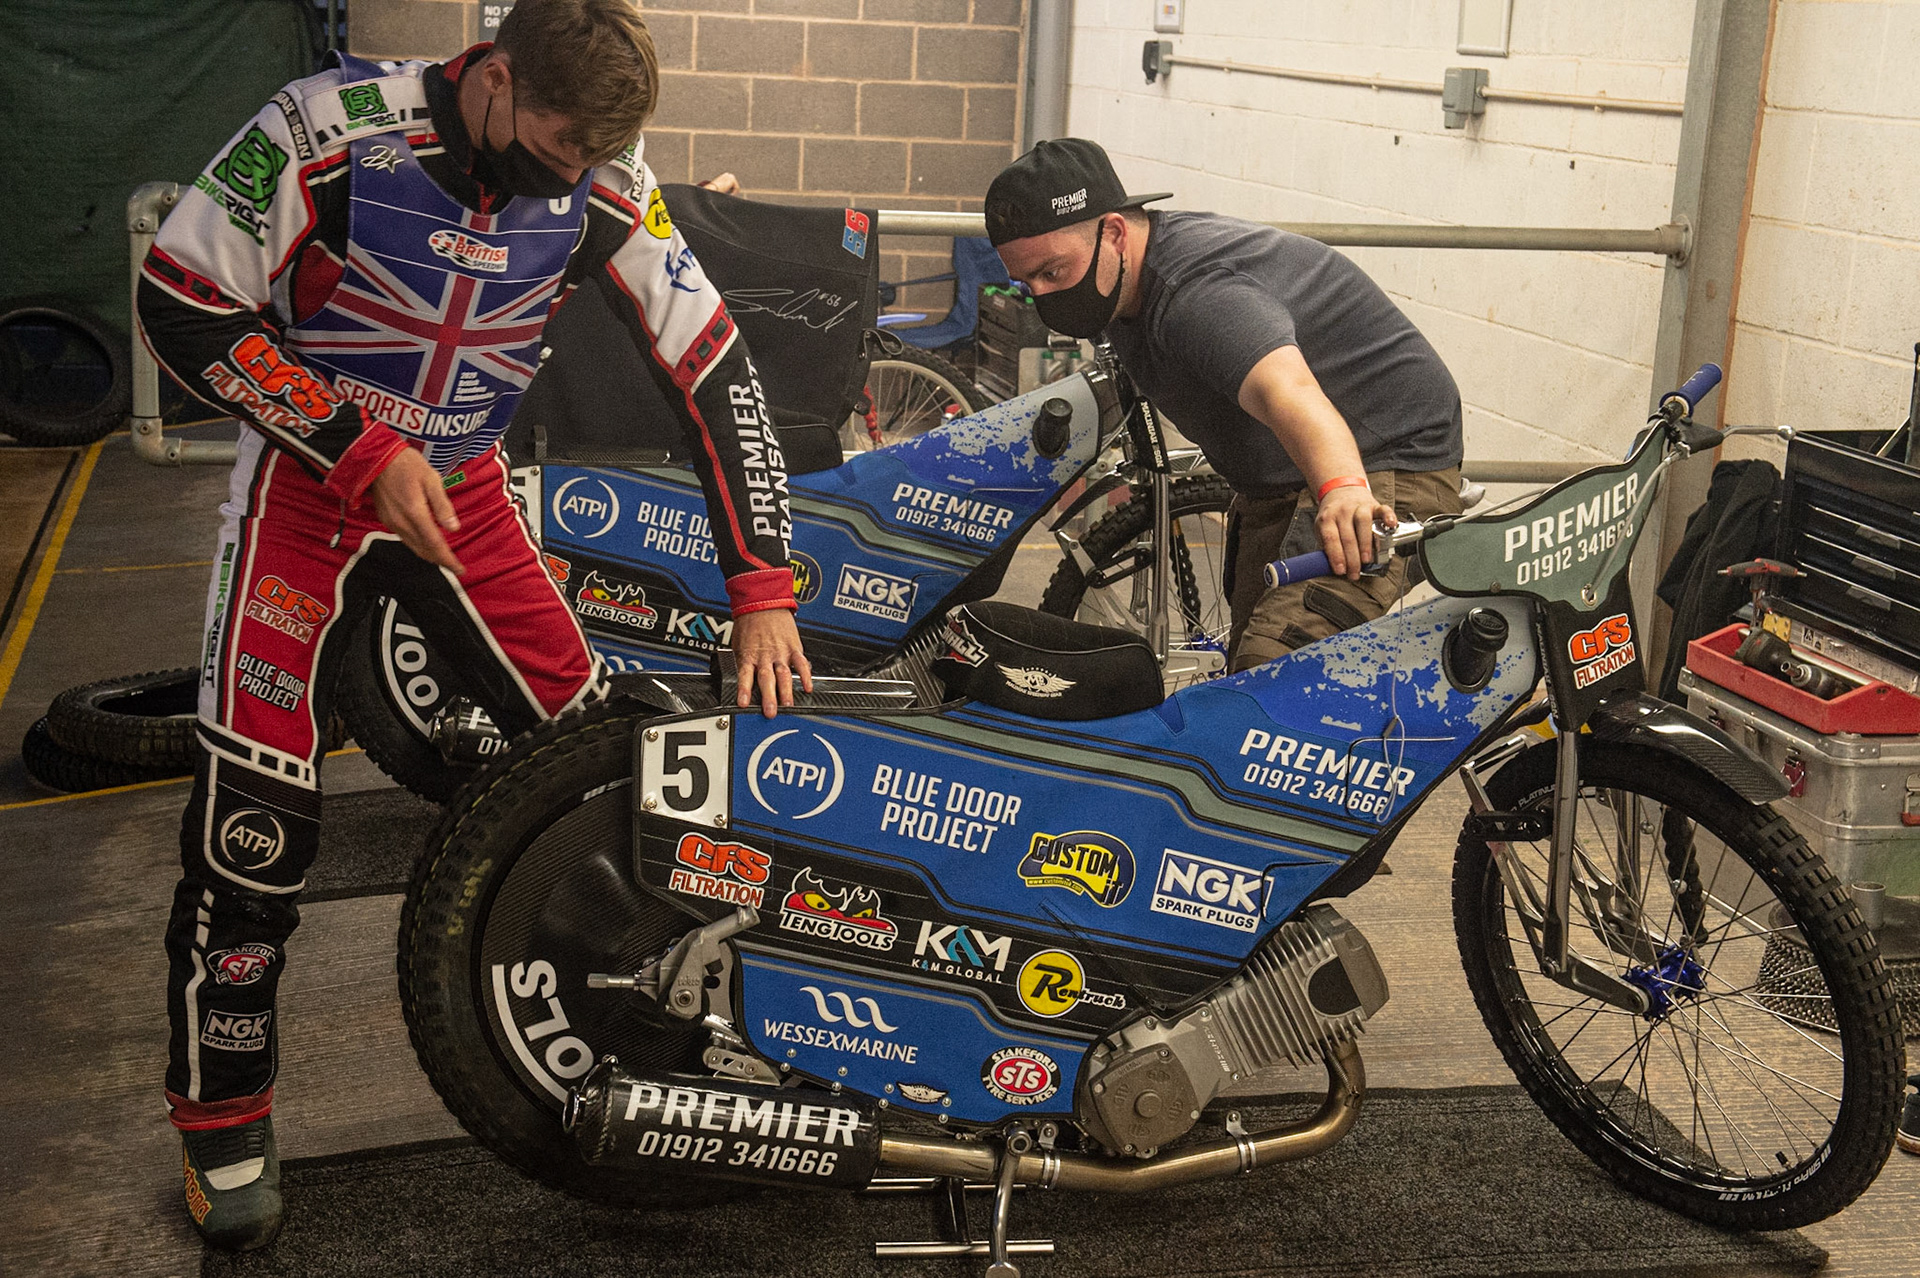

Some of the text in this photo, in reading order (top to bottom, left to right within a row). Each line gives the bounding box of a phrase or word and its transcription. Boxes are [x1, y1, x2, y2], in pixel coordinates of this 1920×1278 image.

[1051, 188, 1088, 209] PREMIER
[201, 361, 320, 438] FILTRATION
[229, 333, 343, 422] CFS
[338, 379, 424, 431] SPORTS
[728, 384, 778, 537] PREMIER
[745, 356, 792, 560] TRANSPORT
[562, 495, 607, 520] ATPI
[637, 502, 684, 532] BLUE
[892, 483, 1014, 530] PREMIER
[895, 506, 996, 543] 01912 341666
[1504, 472, 1639, 562] PREMIER
[1516, 545, 1572, 587] 01912
[254, 575, 329, 625] CFS
[837, 597, 906, 620] SPARK PLUGS
[842, 572, 910, 607] NGK
[245, 600, 314, 644] FILTRATION
[1568, 613, 1631, 664] CFS
[237, 652, 306, 698] BLUE DOOR
[1573, 642, 1636, 689] FILTRATION
[238, 674, 300, 712] PROJECT
[662, 731, 710, 812] 5
[762, 756, 827, 792] ATPI
[1239, 728, 1415, 797] PREMIER
[1243, 762, 1306, 797] 01912
[871, 764, 1022, 826] BLUE DOOR
[227, 825, 277, 858] ATPI
[880, 803, 998, 854] PROJECT
[675, 832, 772, 885] CFS
[1031, 836, 1120, 879] CUSTOM
[669, 868, 765, 909] FILTRATION
[1161, 859, 1260, 914] NGK
[1156, 897, 1256, 930] SPARK PLUGS
[946, 965, 1002, 984] GLOBAL
[1030, 963, 1126, 1010] Rentruck
[203, 1035, 264, 1049] SPARK PLUGS
[207, 1015, 268, 1039] NGK
[764, 1019, 918, 1064] WESSEXMARINE
[991, 1047, 1058, 1073] STAKEFORD
[999, 1061, 1042, 1089] STS
[982, 1075, 1058, 1106] TYRE SERVICES
[623, 1083, 860, 1147] PREMIER
[637, 1130, 838, 1177] 01912 341666
